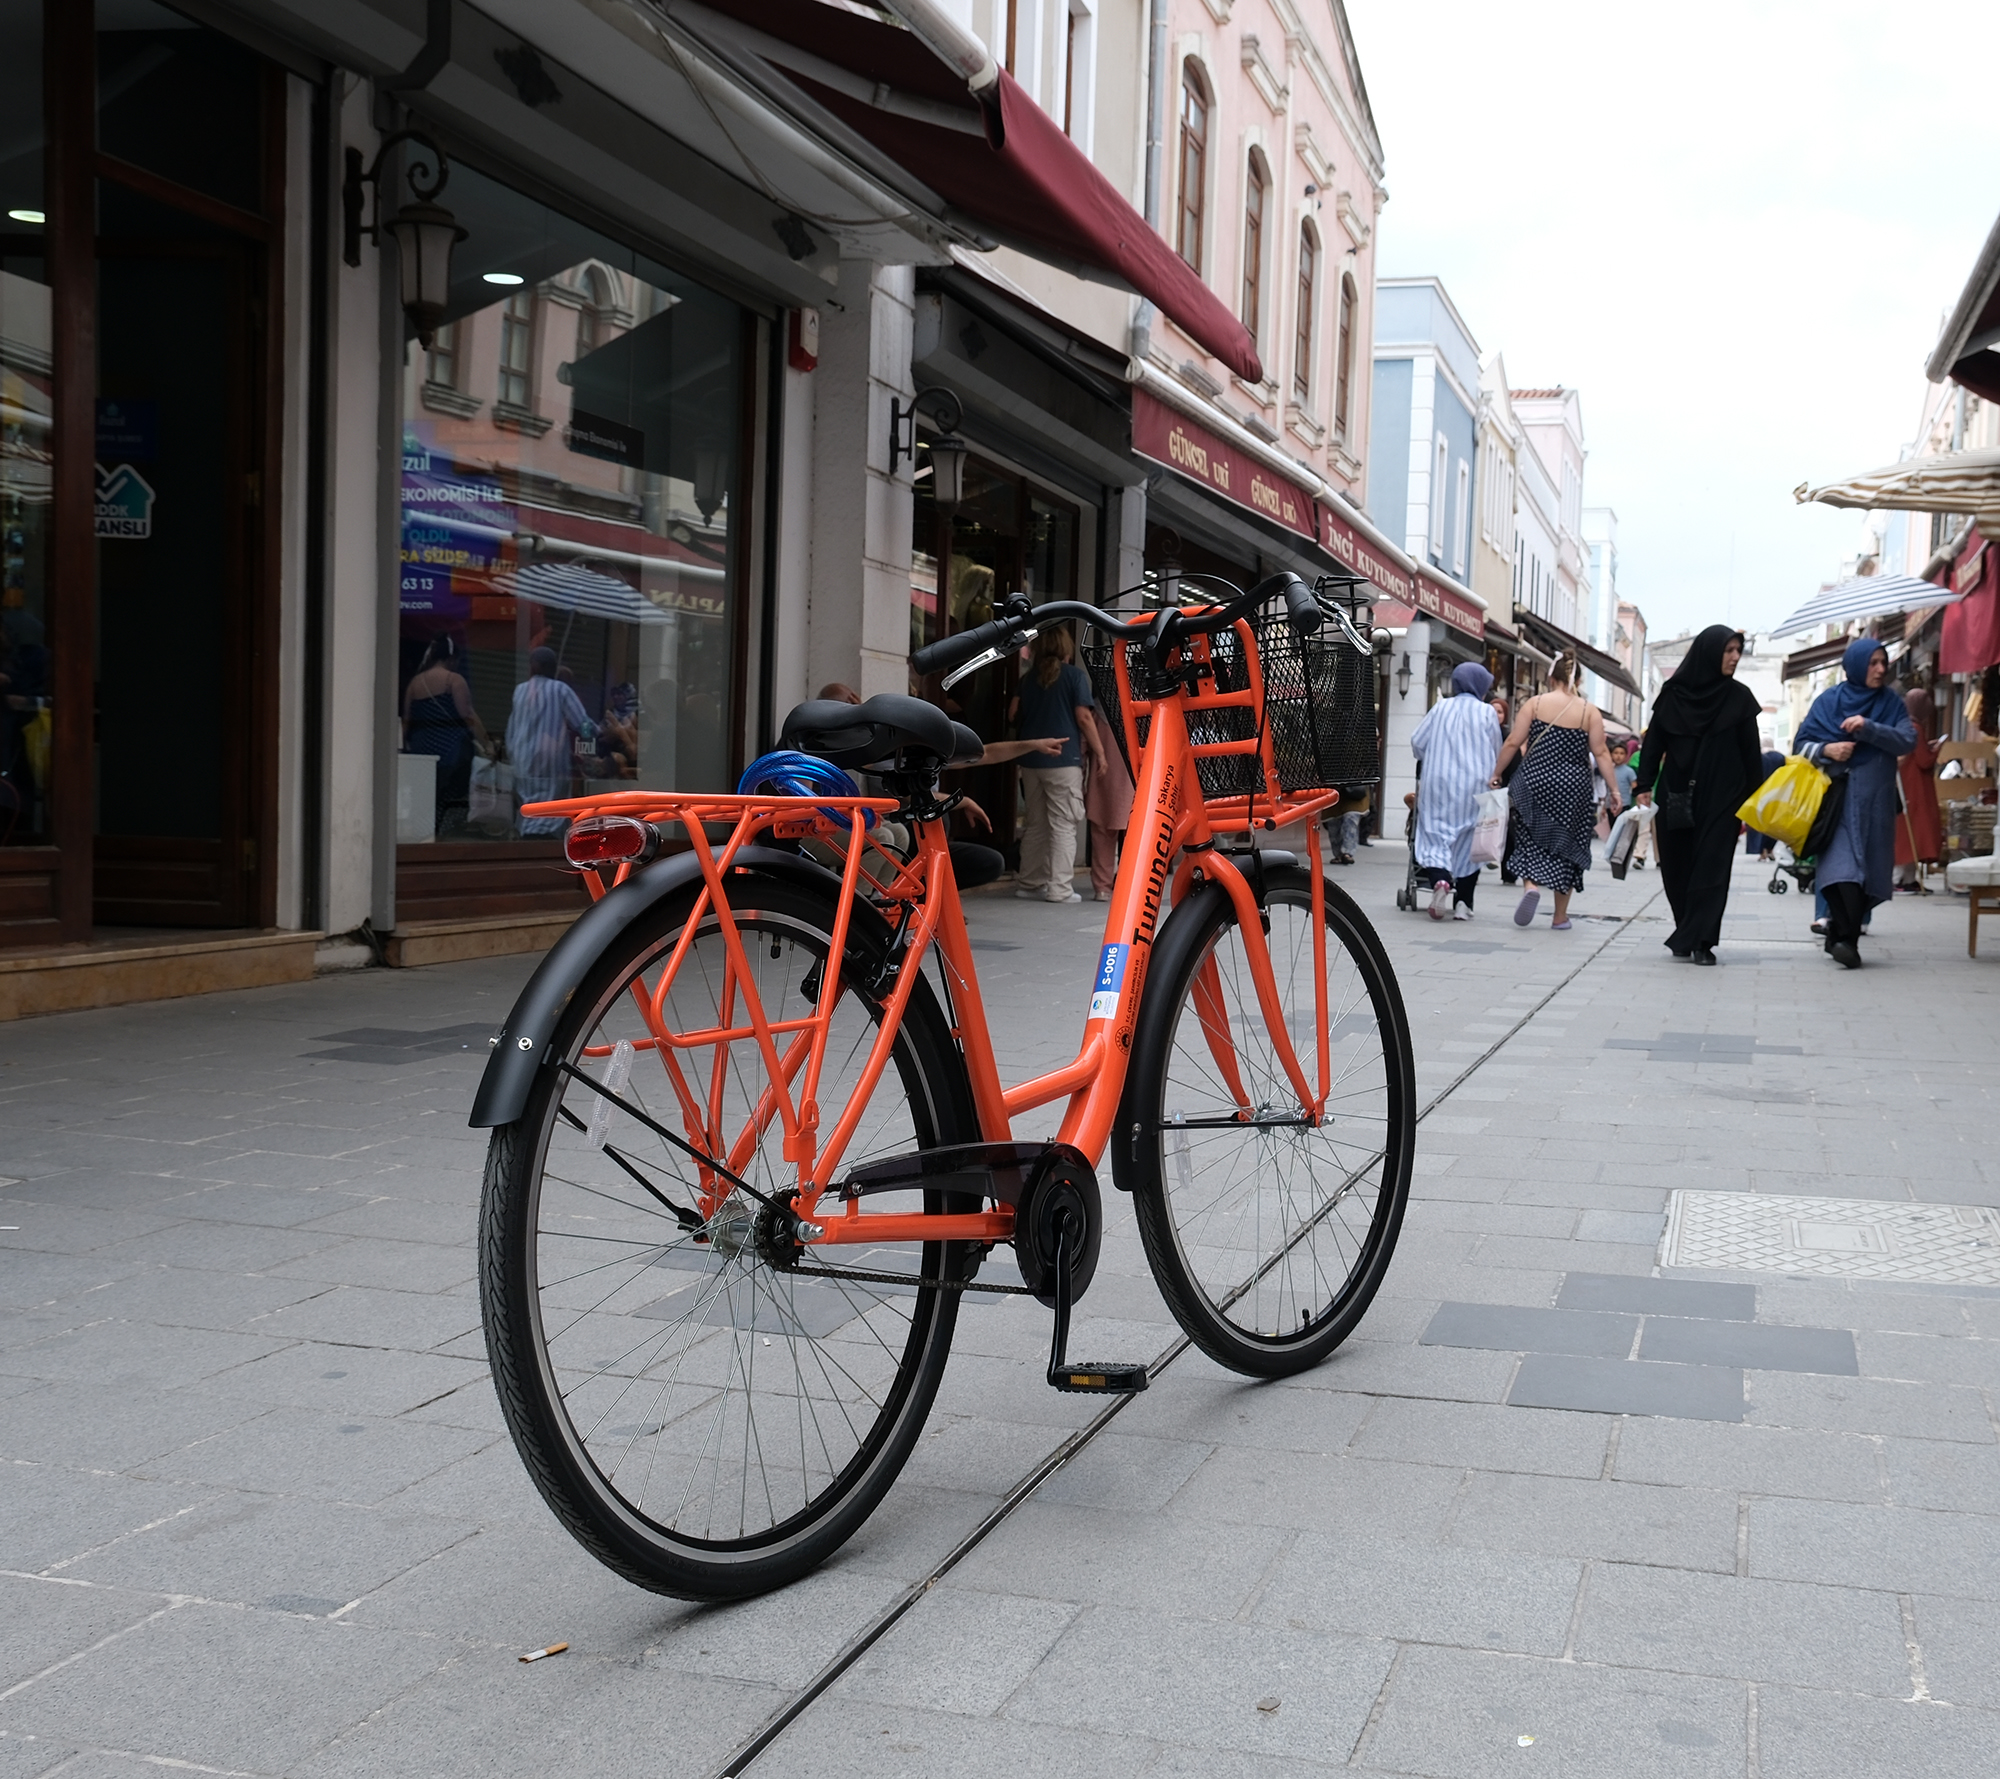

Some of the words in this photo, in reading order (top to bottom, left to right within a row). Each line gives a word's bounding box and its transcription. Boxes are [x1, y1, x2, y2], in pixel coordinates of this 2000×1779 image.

[95, 519, 147, 536] ANSLI
[1328, 513, 1354, 564] İNCİ
[1357, 549, 1409, 600] KUYUMCU
[401, 578, 418, 591] 63
[420, 578, 434, 591] 13
[1418, 578, 1440, 613] İNCİ
[1443, 601, 1481, 634] KUYUMCU
[1158, 764, 1174, 806] Sakarya
[1133, 821, 1174, 947] Turuncu
[1101, 946, 1119, 986] S-0016
